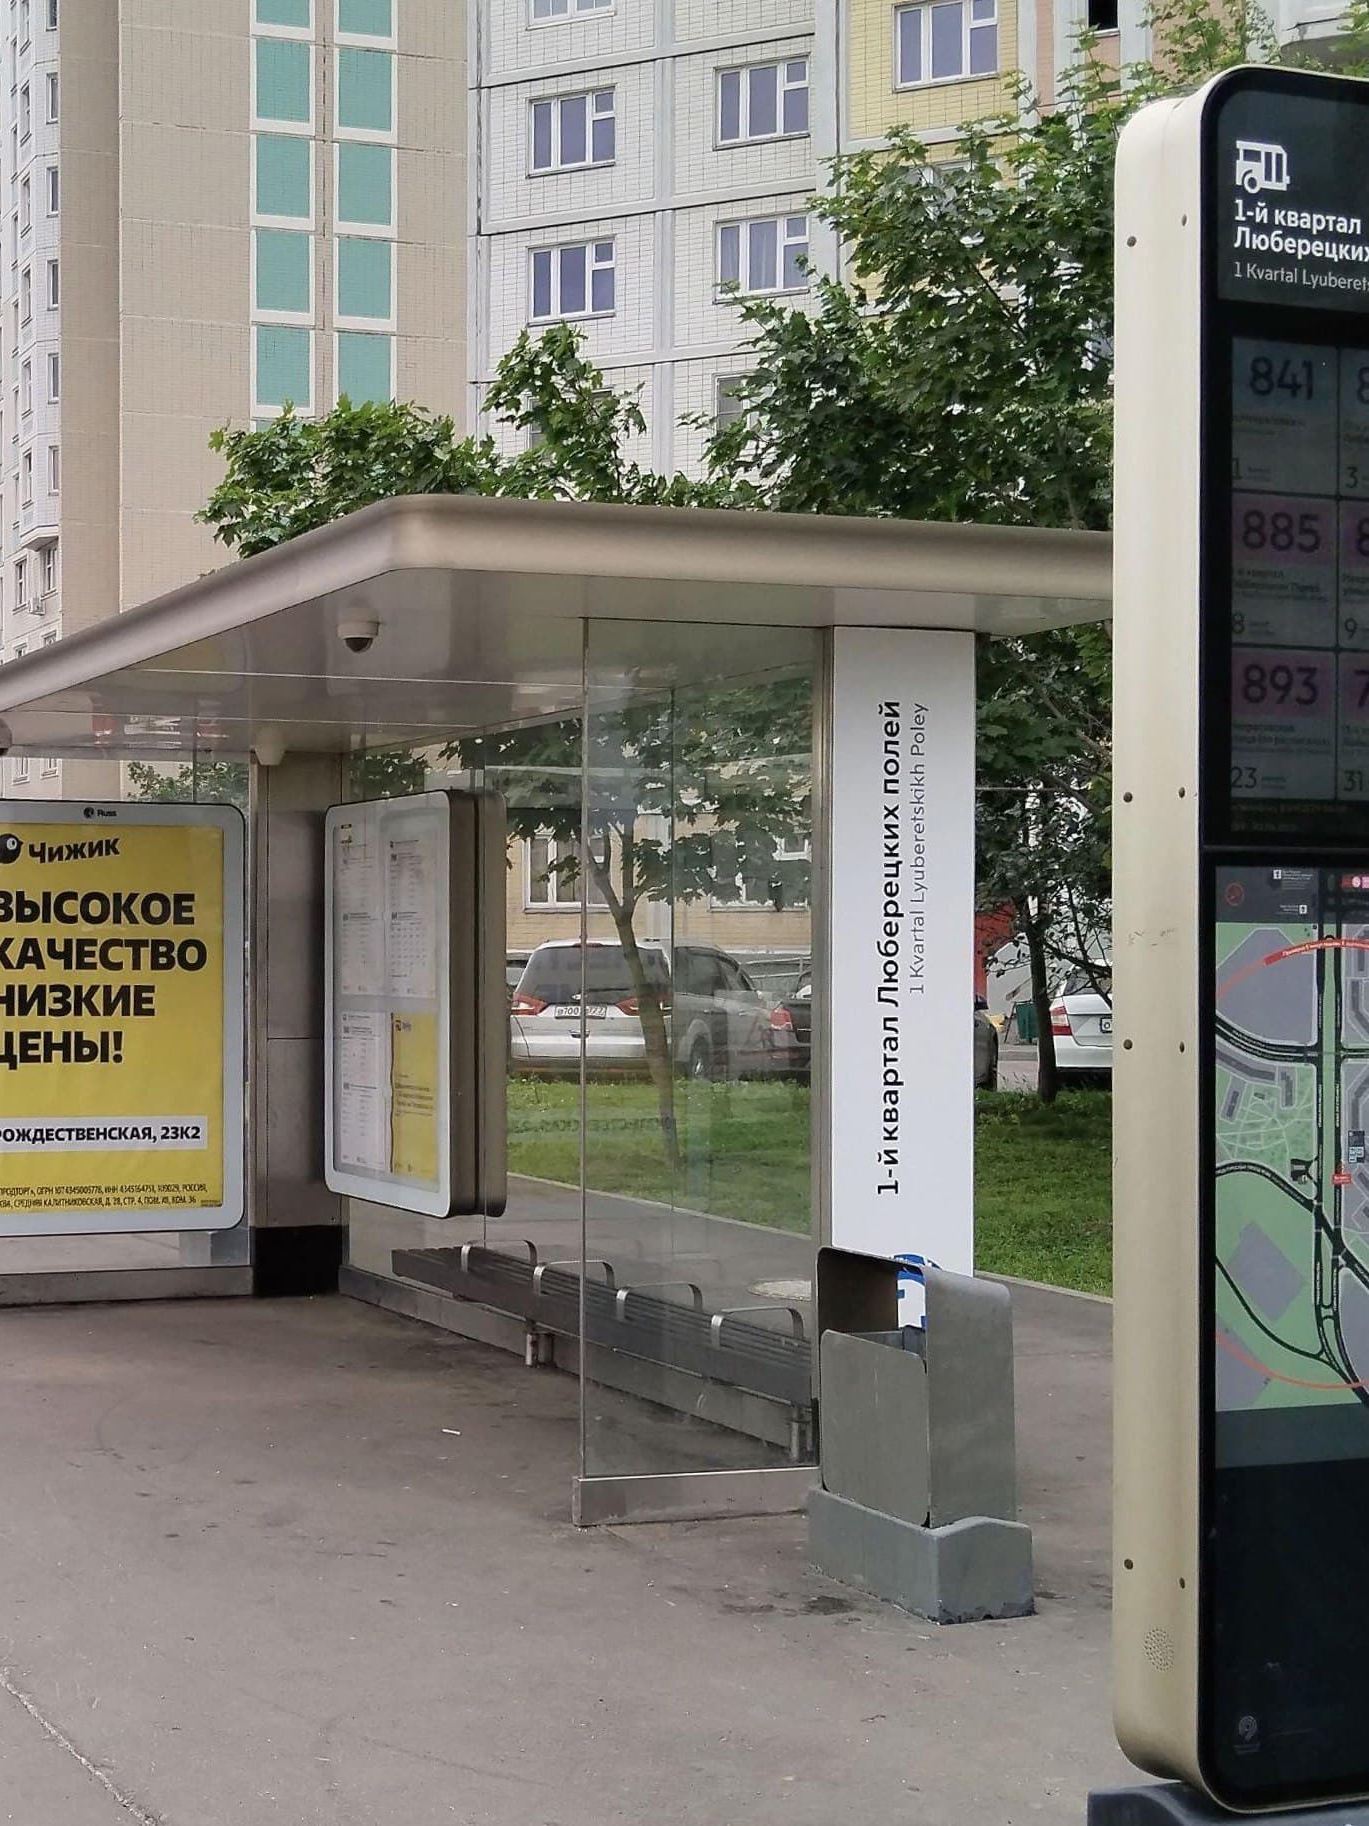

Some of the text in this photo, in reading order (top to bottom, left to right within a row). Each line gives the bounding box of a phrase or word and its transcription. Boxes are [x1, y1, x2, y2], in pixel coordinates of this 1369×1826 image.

[1234, 199, 1361, 235] 1-й квартал
[1234, 262, 1369, 291] 1 Kvartal Lyuberet
[1249, 356, 1314, 400] 841
[1242, 509, 1321, 552] 885
[1243, 663, 1319, 705] 893
[1230, 766, 1257, 789] 23
[28, 837, 121, 864] Чижик
[909, 702, 929, 994] 1 Kvartal Lyuberetskikh Poley
[876, 701, 905, 1195] 1-й квартал Люберецких полей
[160, 1126, 201, 1140] 23К2
